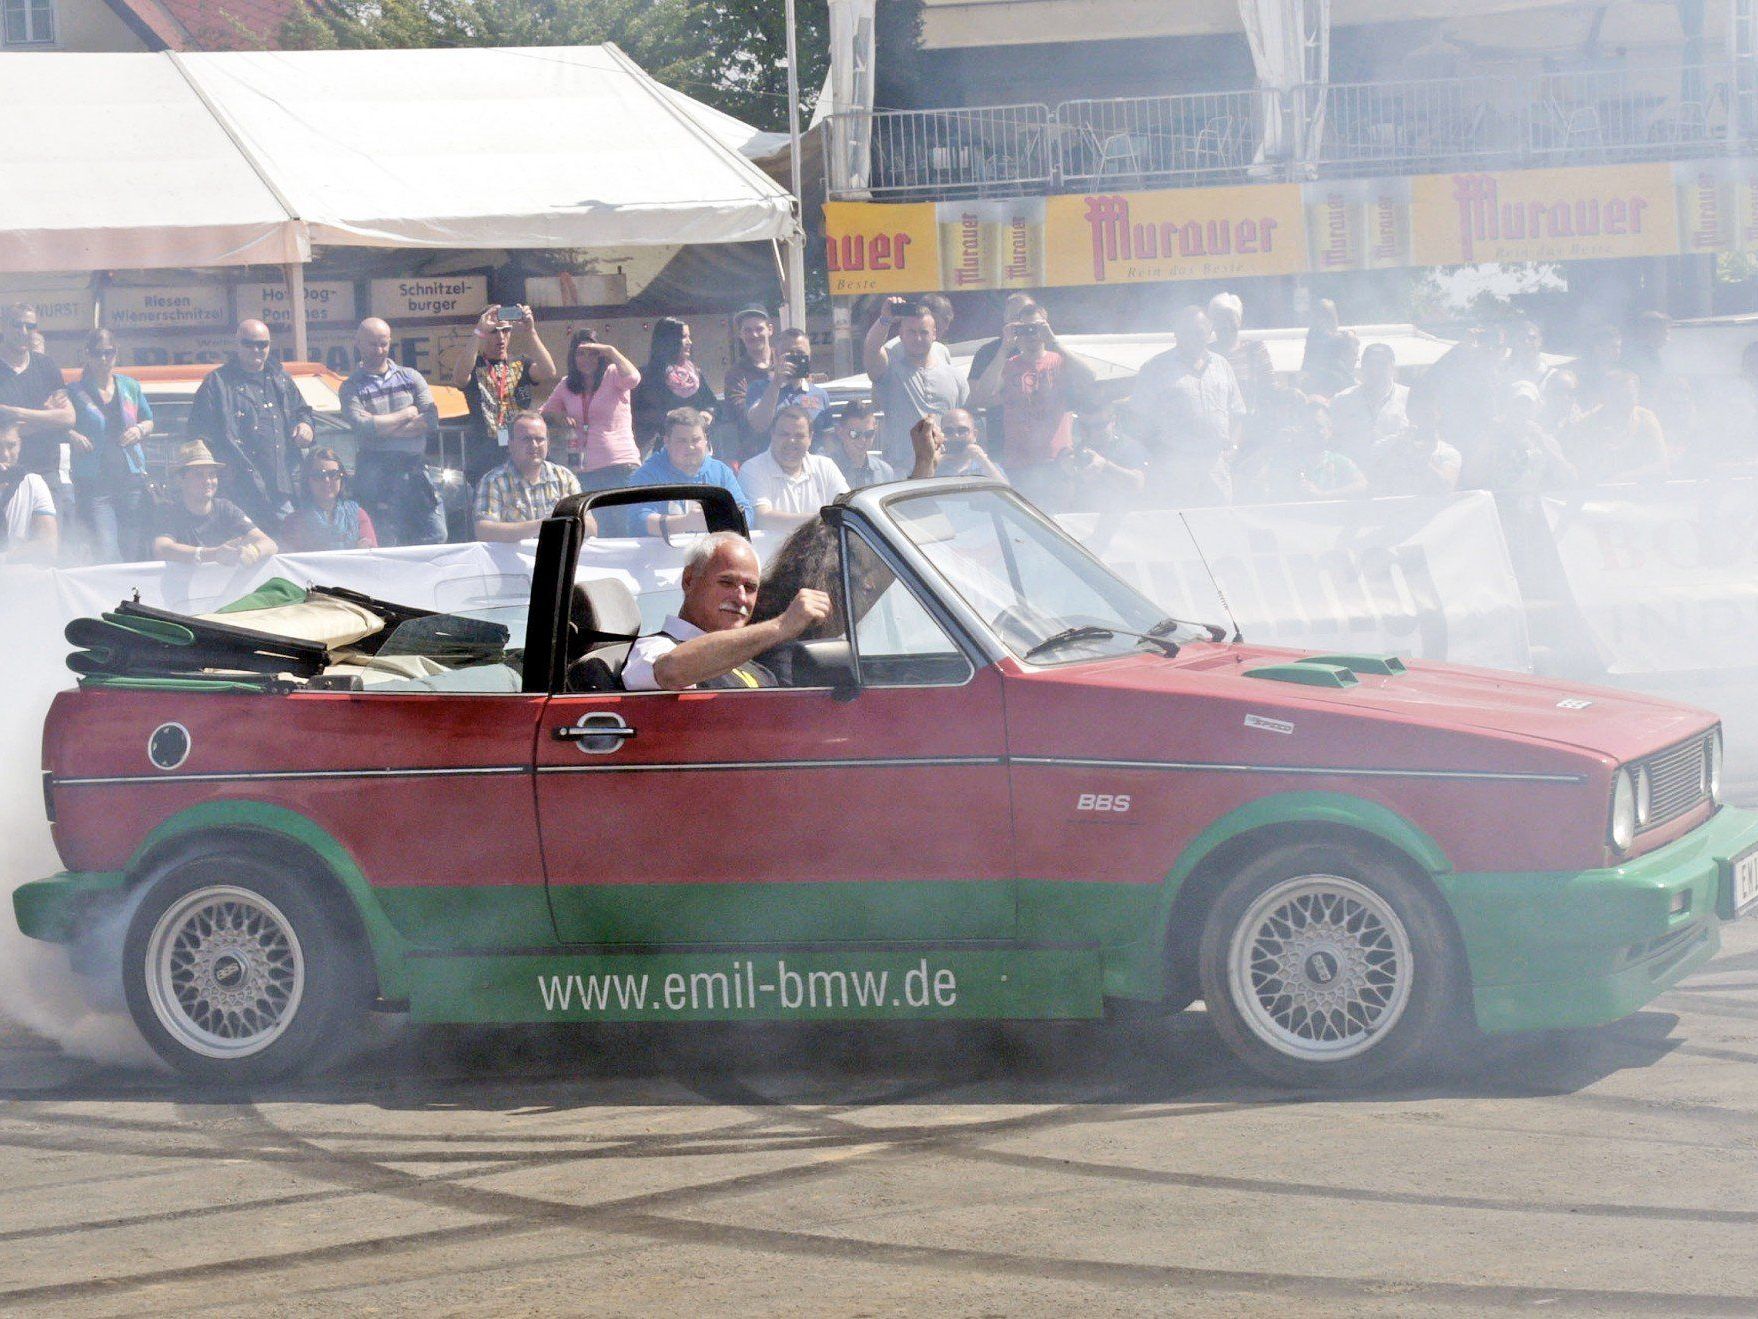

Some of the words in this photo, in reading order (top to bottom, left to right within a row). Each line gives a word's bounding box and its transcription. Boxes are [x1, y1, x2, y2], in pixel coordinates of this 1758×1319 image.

[1451, 174, 1649, 262] Murauer
[1083, 195, 1278, 281] Murauer
[955, 212, 987, 287] Murauer
[1005, 216, 1032, 280] Murauer
[399, 278, 473, 297] Schnitzel-
[836, 278, 877, 290] Beste
[144, 295, 191, 308] Riesen
[262, 288, 290, 302] Ho
[408, 298, 457, 314] burger
[112, 307, 223, 324] Wienerschnitzel
[1076, 794, 1131, 812] BBS
[538, 958, 957, 1011] www.emil-bmw.de
